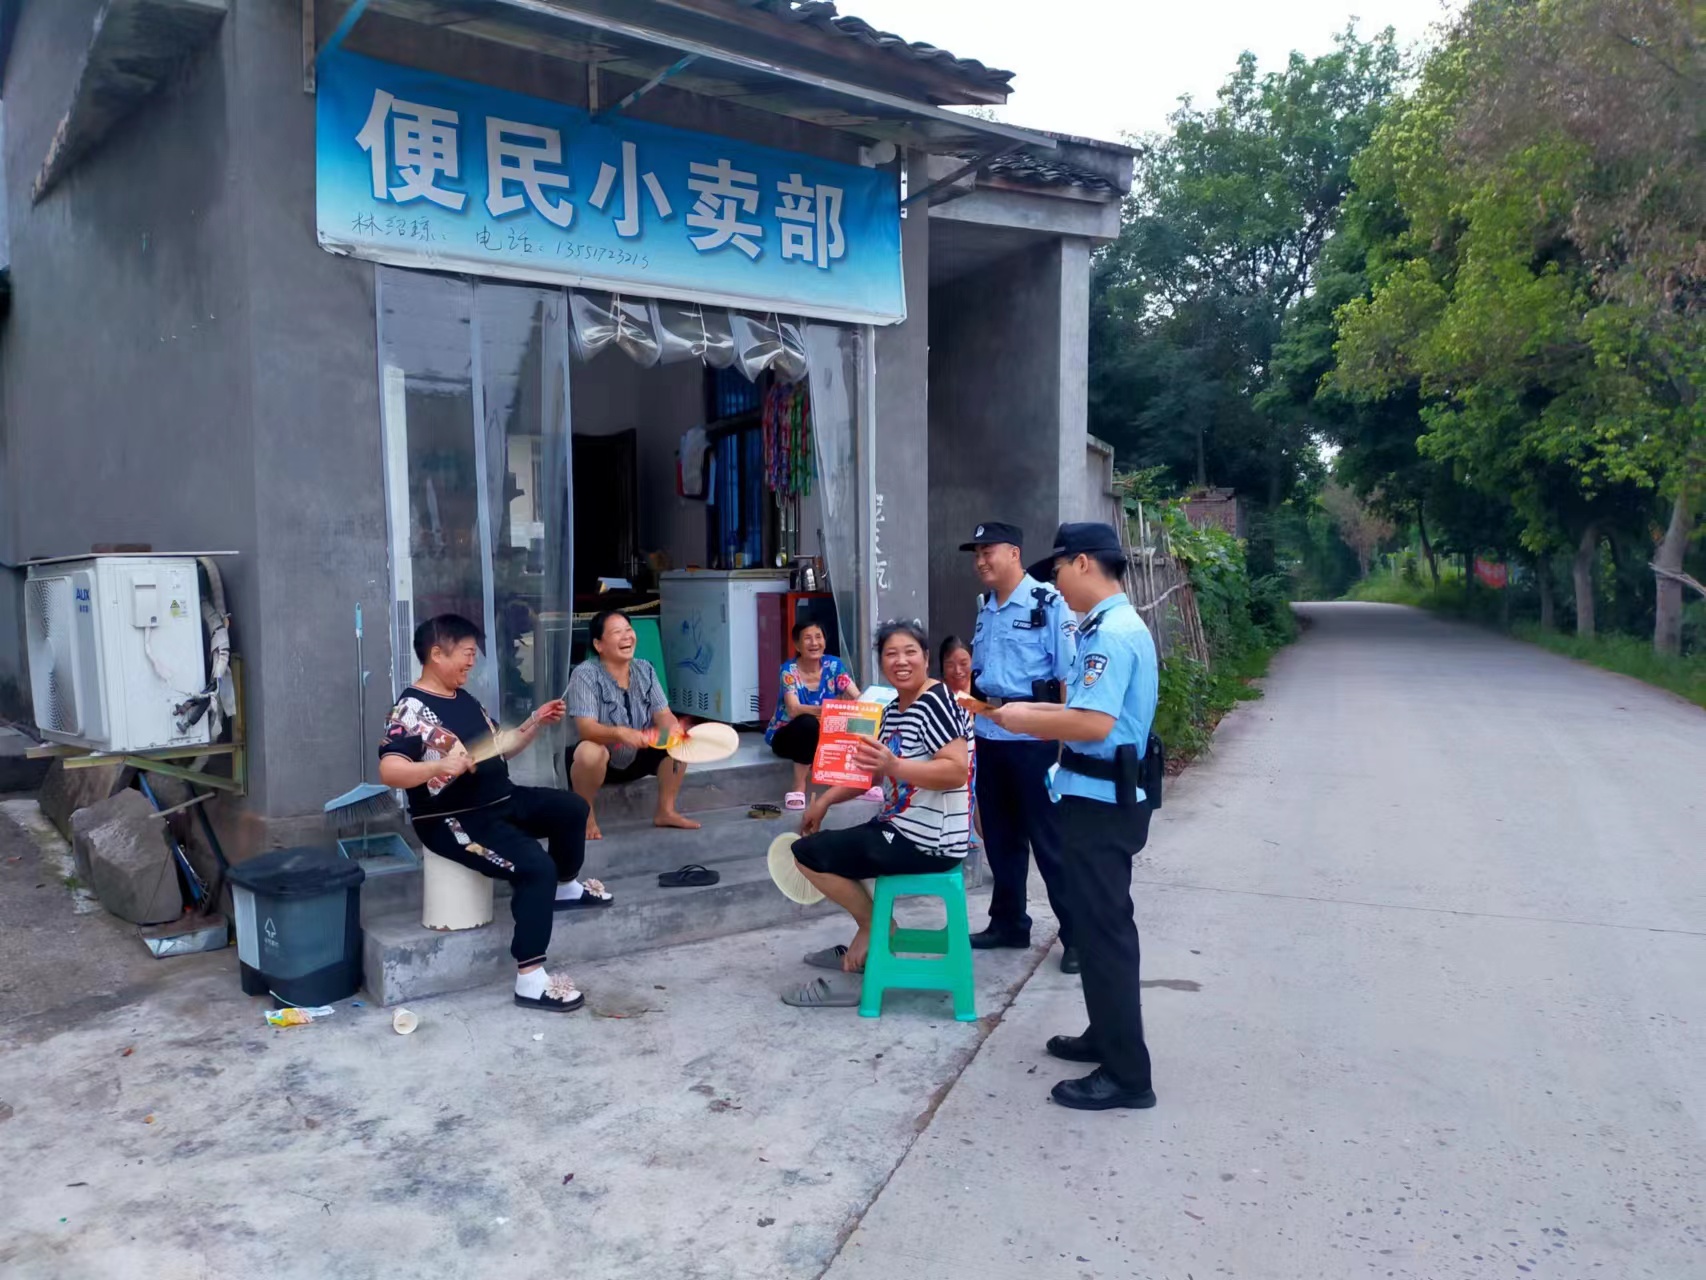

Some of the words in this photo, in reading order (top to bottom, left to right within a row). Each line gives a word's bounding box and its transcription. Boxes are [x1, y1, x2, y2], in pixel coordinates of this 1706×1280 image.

[354, 89, 846, 268] 便民小卖部
[76, 588, 90, 601] AUX
